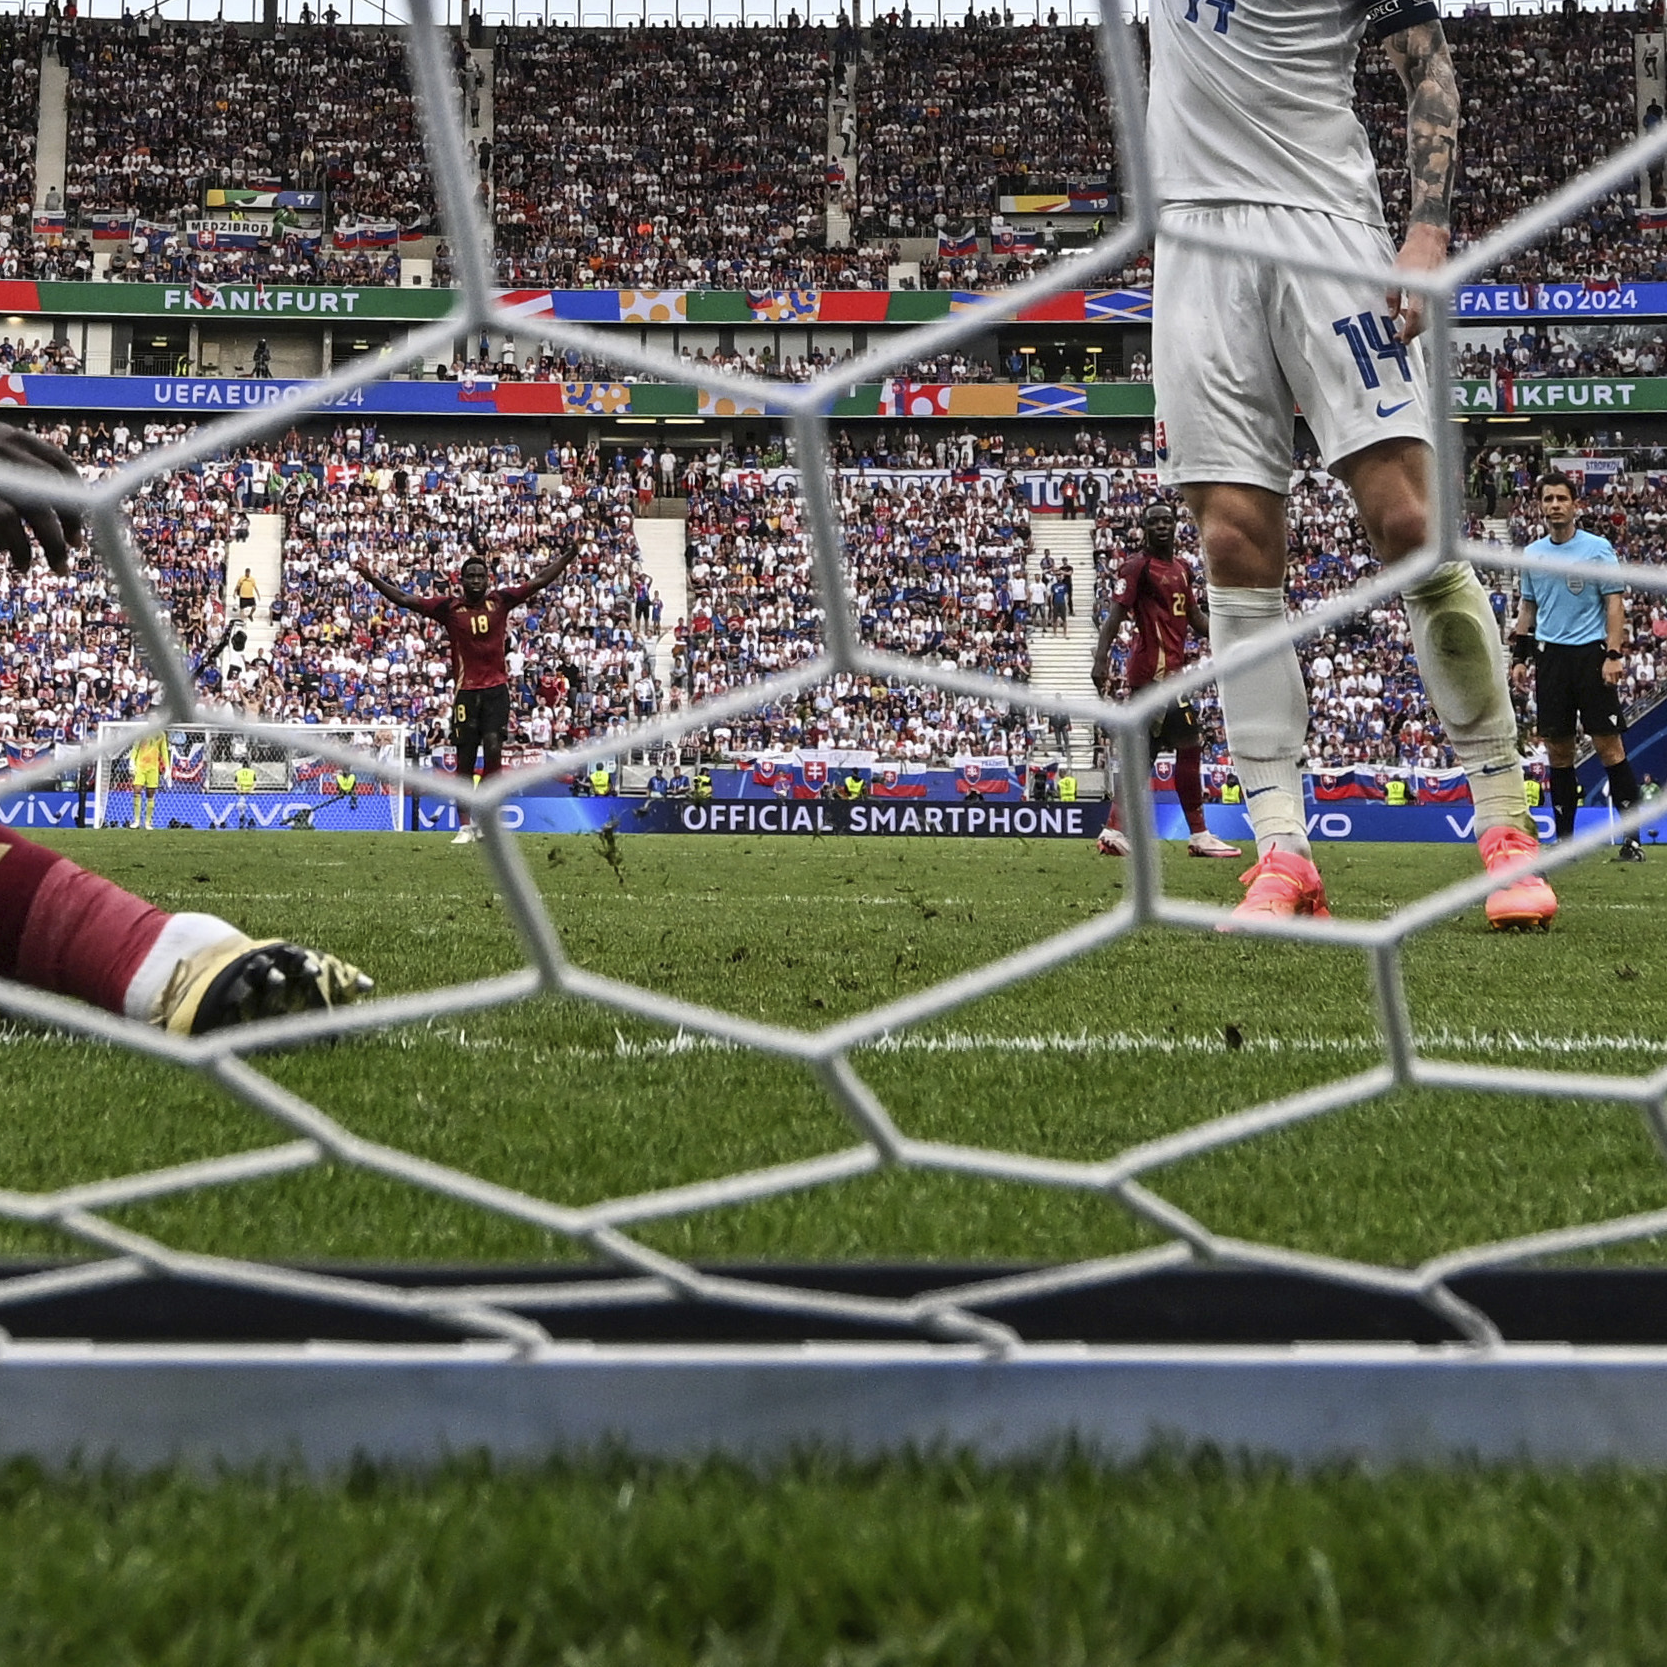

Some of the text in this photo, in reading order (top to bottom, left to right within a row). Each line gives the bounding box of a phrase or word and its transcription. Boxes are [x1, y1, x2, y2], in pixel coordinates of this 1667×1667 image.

[297, 194, 315, 206] 17
[1090, 198, 1109, 209] 19
[1332, 311, 1412, 390] 14
[470, 615, 489, 635] 18
[683, 804, 1084, 834] OFFICIAL SMARTPHONE
